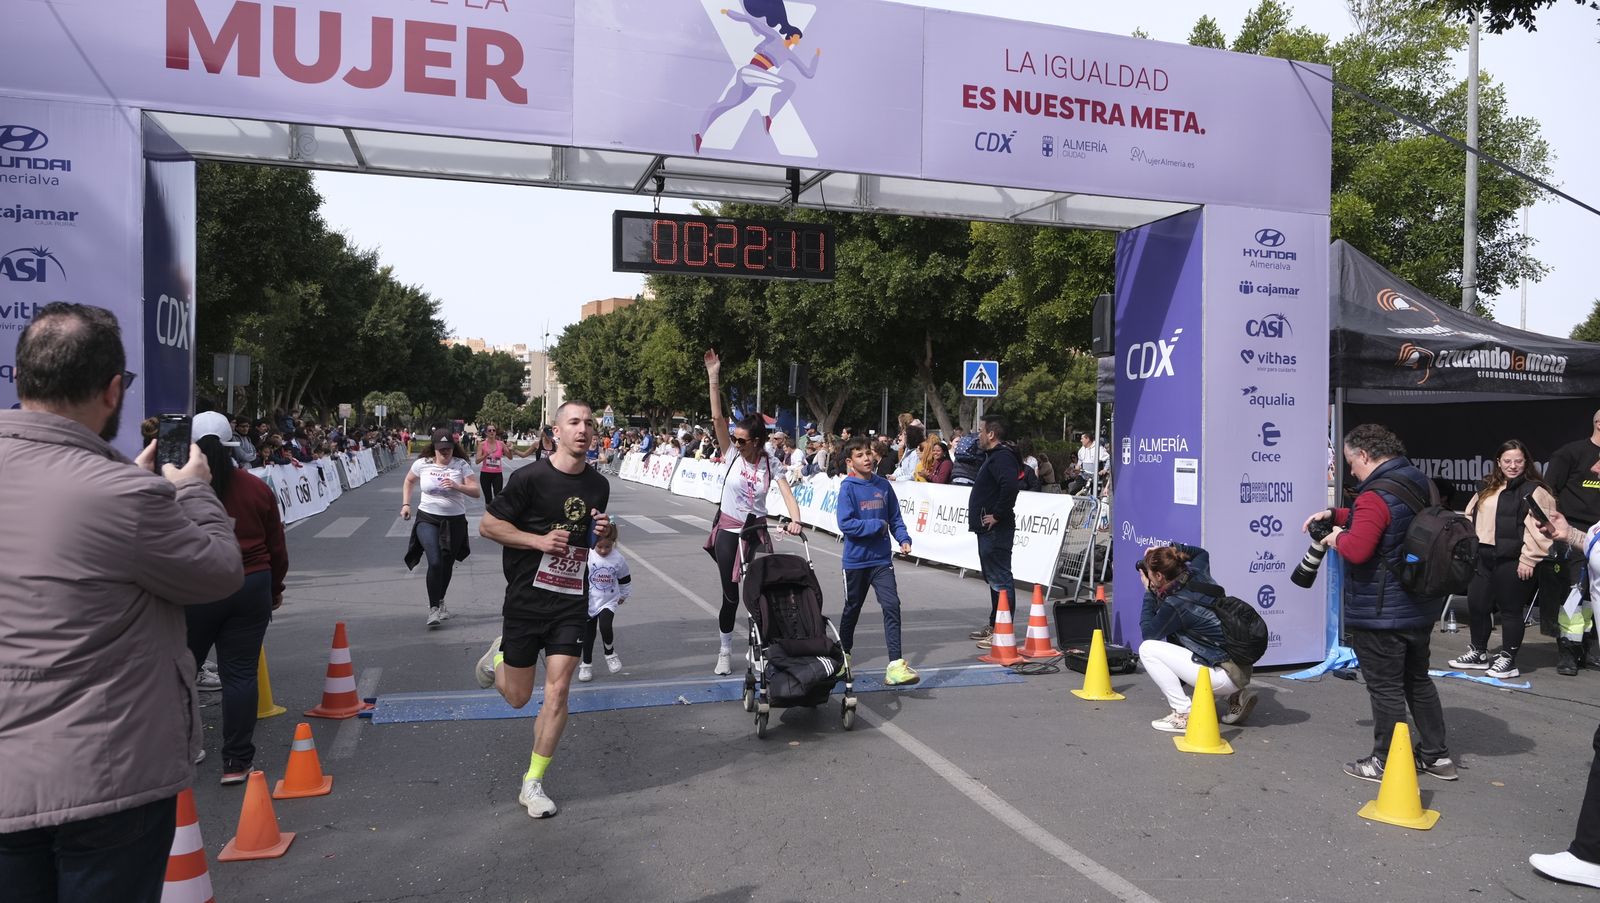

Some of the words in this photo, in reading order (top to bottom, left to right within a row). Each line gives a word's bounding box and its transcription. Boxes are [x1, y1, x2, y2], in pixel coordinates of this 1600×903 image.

[165, 0, 528, 105] MUJER
[1005, 48, 1036, 75] LA
[1044, 53, 1169, 92] IGUALDAD
[962, 84, 997, 111] ES
[1003, 88, 1126, 127] NUESTRA
[1130, 105, 1206, 135] META.
[974, 131, 1016, 153] CDX
[1063, 137, 1108, 153] ALMERÍA
[652, 219, 824, 272] 00:22:11
[1243, 248, 1297, 261] HYUNDAI
[1256, 283, 1300, 296] cajamar
[156, 294, 190, 350] CDX
[1245, 319, 1284, 338] CASI
[1126, 332, 1181, 380] CDX
[1257, 351, 1297, 365] vithas
[1249, 392, 1295, 408] aqualia
[1138, 434, 1188, 452] ALMERÍA
[1138, 453, 1163, 464] CIUDAD
[1251, 451, 1281, 462] Clece
[1268, 482, 1293, 503] CASH
[1249, 515, 1283, 537] ego
[547, 556, 581, 573] 2523
[1249, 560, 1286, 573] Lanjarón
